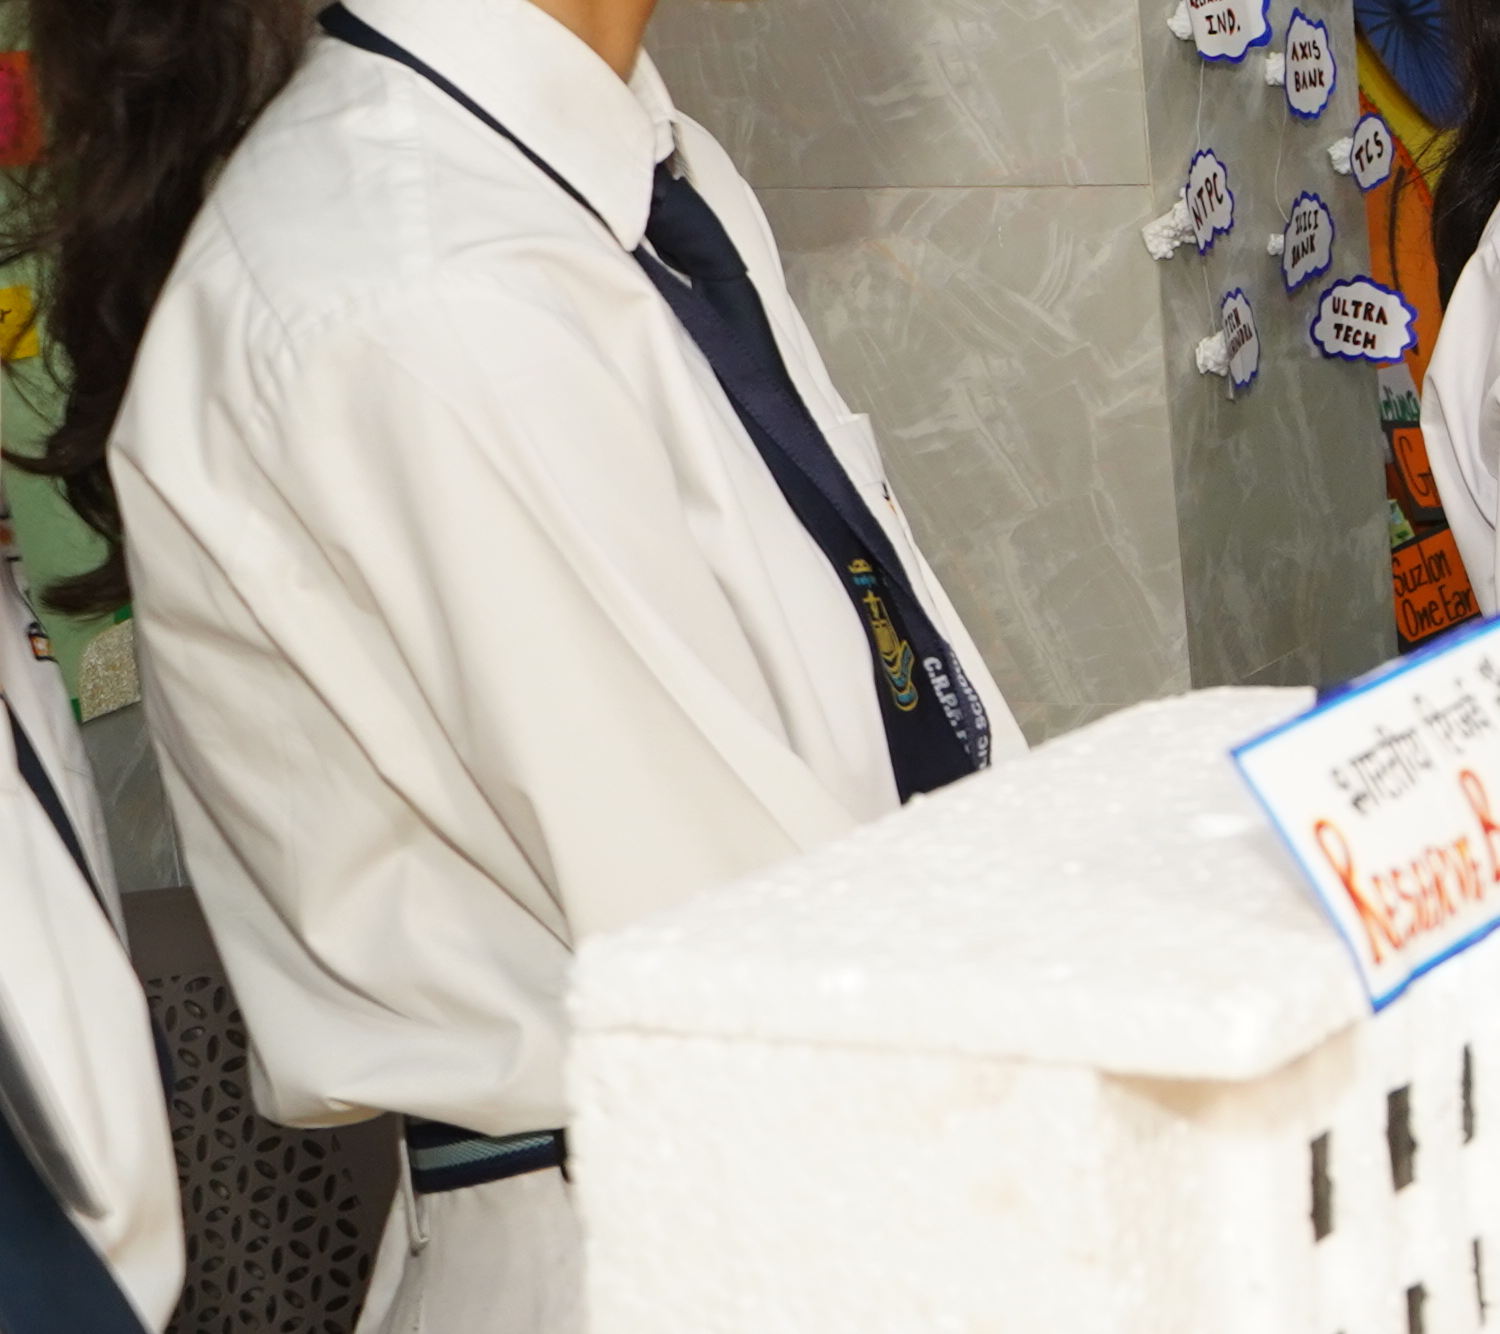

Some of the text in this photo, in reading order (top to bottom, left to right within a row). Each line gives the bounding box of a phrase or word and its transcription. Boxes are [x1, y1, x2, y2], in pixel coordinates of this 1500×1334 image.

[1206, 9, 1241, 36] IND.
[1292, 40, 1321, 61] AXIS
[1294, 70, 1325, 92] BANK
[1355, 131, 1384, 172] TCS
[1192, 172, 1224, 229] NTPC
[1292, 243, 1316, 268] BANK
[1332, 297, 1388, 325] ULTRA
[1334, 323, 1376, 350] TECH
[1393, 543, 1453, 598] Suzlon
